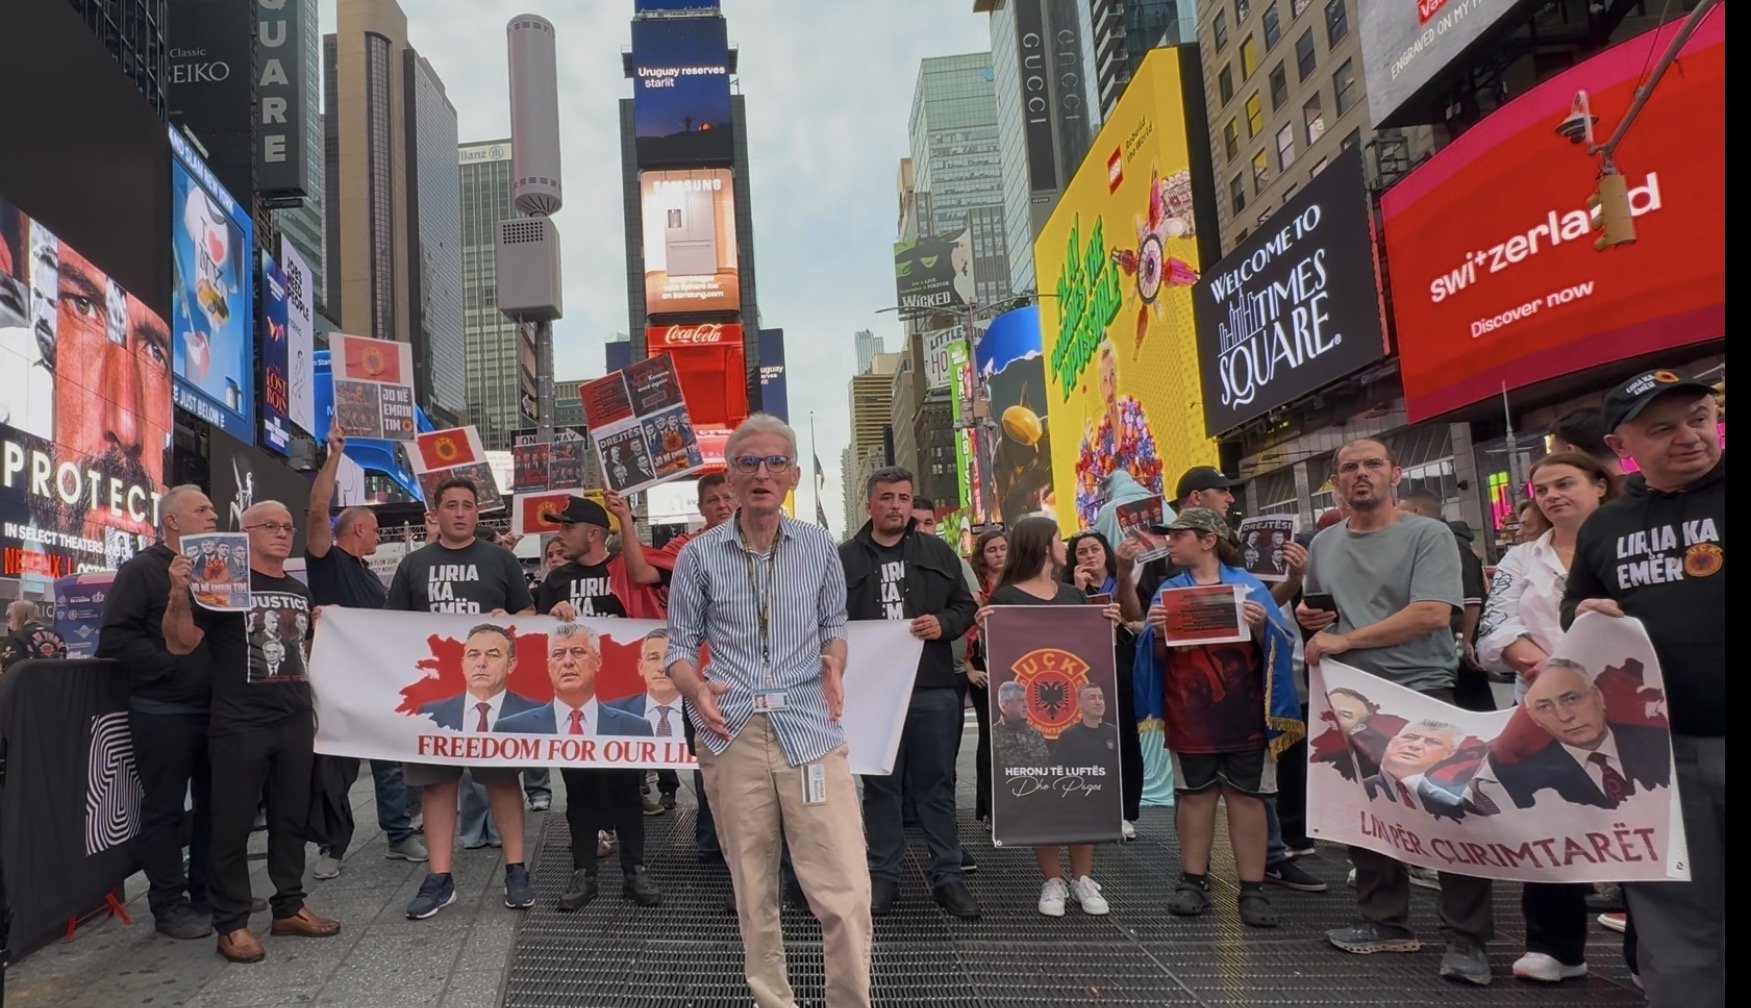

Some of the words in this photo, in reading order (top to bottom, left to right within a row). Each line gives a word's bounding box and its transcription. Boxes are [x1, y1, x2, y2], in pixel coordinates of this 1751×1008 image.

[169, 47, 207, 58] Classic
[1390, 28, 1435, 80] ENGRAVED
[1436, 14, 1452, 35] ON
[1453, 1, 1470, 23] MY
[168, 61, 230, 83] EIKO
[638, 67, 680, 77] Uruguay
[681, 66, 725, 75] reserves
[645, 77, 675, 88] starlit
[1022, 32, 1047, 124] GUCCI
[1210, 225, 1294, 305] WELCOME
[1292, 204, 1322, 241] TO
[1252, 248, 1327, 328] TIMES
[1471, 299, 1544, 340] Discover
[1547, 280, 1595, 308] now
[930, 327, 962, 351] LITTLE
[5, 522, 17, 538] IN
[19, 525, 58, 546] SELECT
[59, 533, 104, 554] THEATERS
[1681, 517, 1721, 547] KA
[428, 564, 480, 582] LIRIA
[428, 581, 454, 602] KA
[1022, 652, 1078, 677] UÇK
[418, 735, 541, 760] FREEDOM
[547, 739, 597, 761] FOR
[603, 740, 657, 763] OUR
[1005, 766, 1049, 777] HERONJ
[1050, 765, 1064, 776] TË
[1066, 765, 1106, 776] LUFTËS
[1430, 822, 1659, 869] ÇLIRIMTARËT
